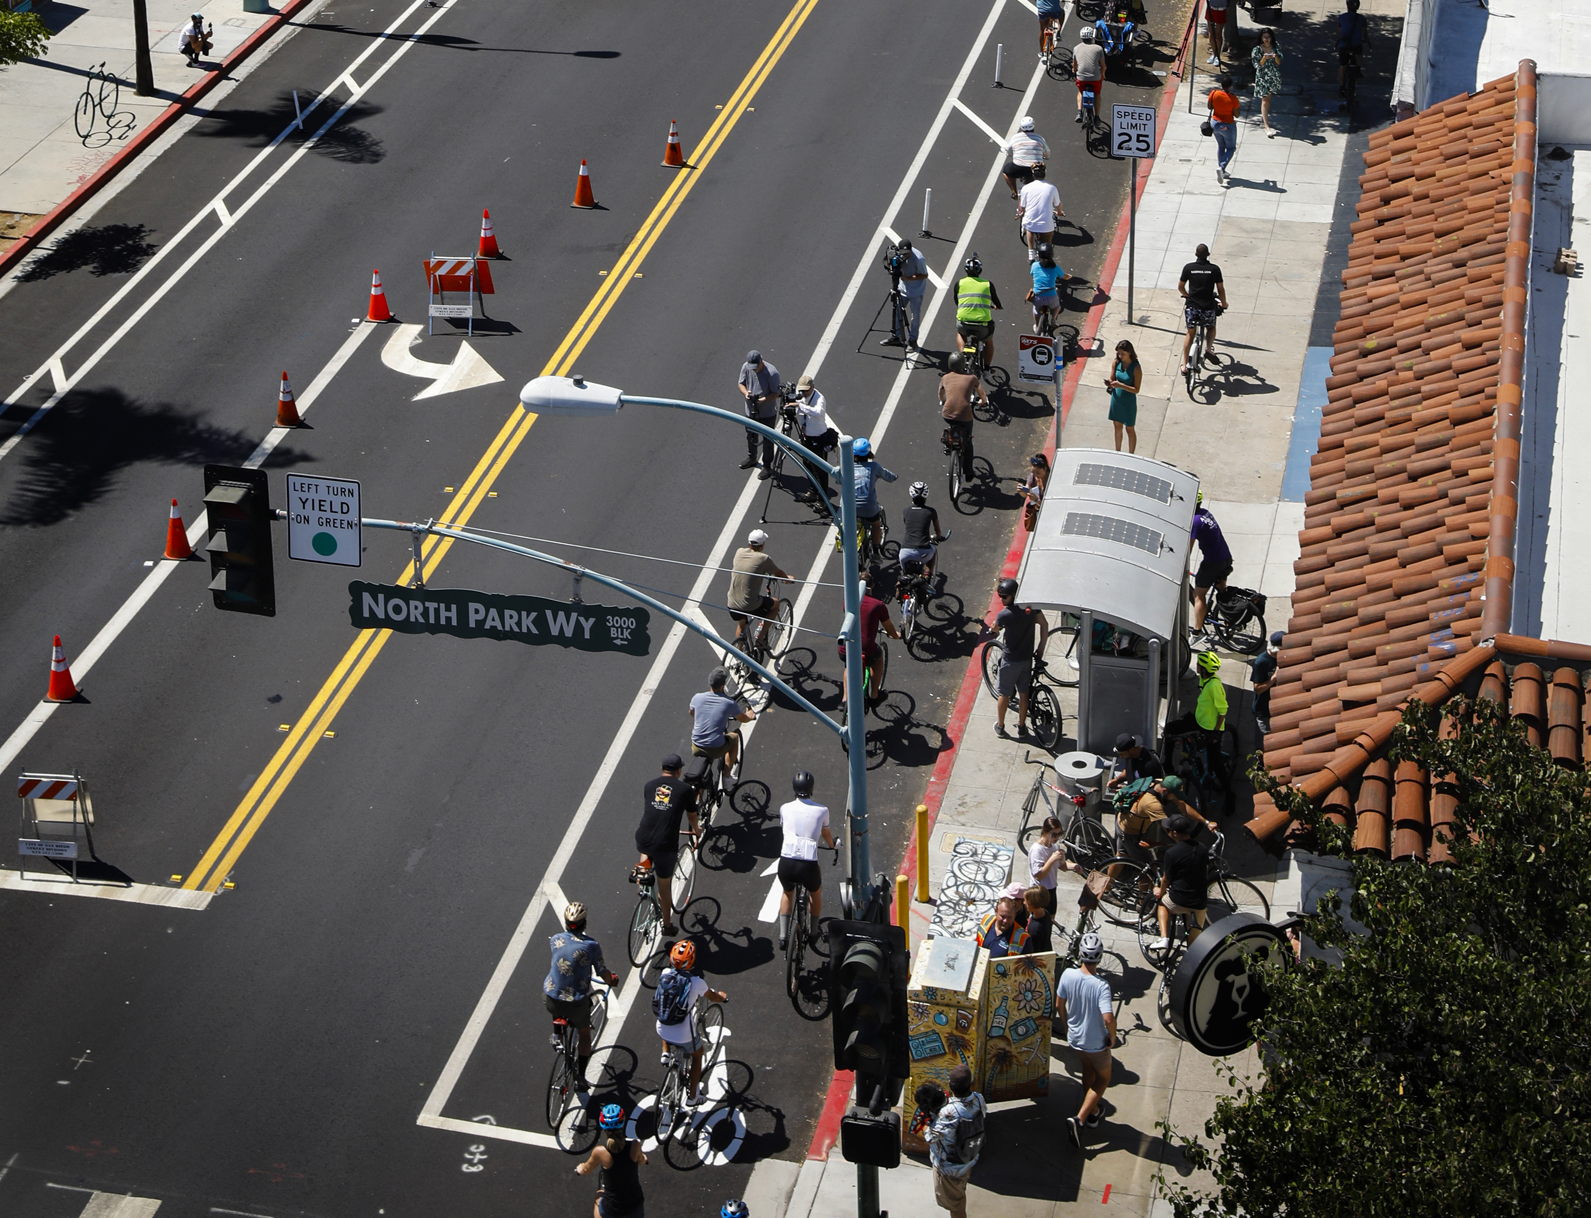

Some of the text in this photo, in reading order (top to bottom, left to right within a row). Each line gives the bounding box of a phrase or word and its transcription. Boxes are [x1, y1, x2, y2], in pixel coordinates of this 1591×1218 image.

[1116, 111, 1152, 121] SPEED
[1120, 122, 1148, 131] LIMIT
[1117, 132, 1150, 152] 25
[293, 482, 354, 498] LEFT TURN
[298, 497, 350, 514] YIELD
[296, 514, 353, 530] ON GREEN
[362, 591, 596, 639] NORTH PARK WY
[606, 616, 636, 629] 3000
[610, 627, 632, 639] BLK
